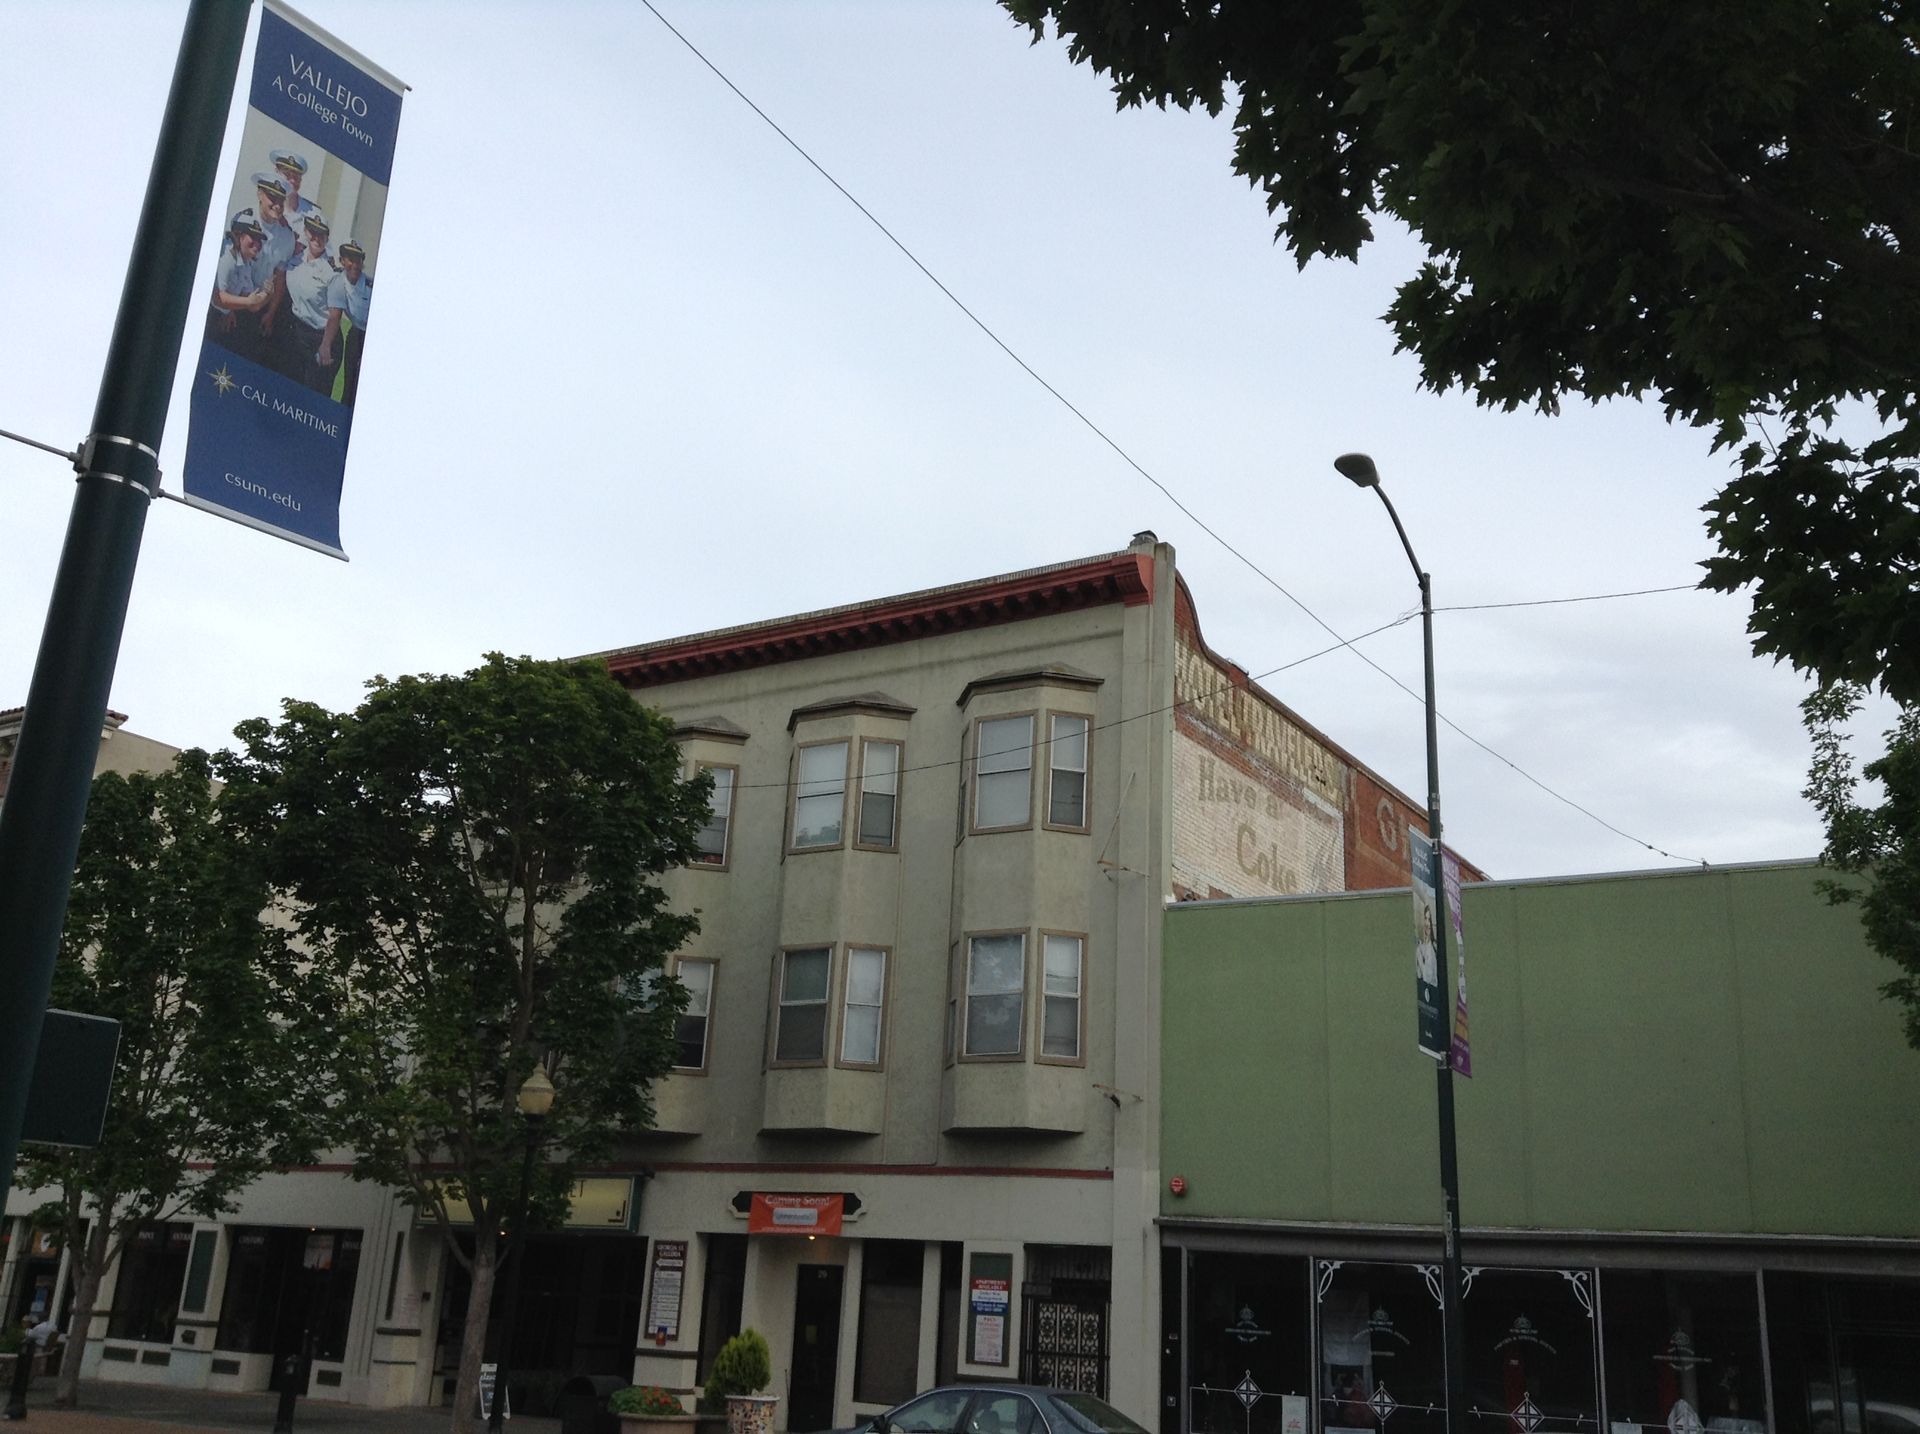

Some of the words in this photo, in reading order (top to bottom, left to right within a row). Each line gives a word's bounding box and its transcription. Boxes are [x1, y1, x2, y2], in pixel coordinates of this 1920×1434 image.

[272, 75, 283, 91] A
[287, 83, 337, 124] College
[341, 114, 373, 147] Town
[290, 54, 368, 118] VALLEJO
[241, 385, 268, 406] CAL
[272, 399, 338, 438] MARITIME
[225, 472, 301, 512] csum.edu
[1199, 754, 1257, 810] Have
[1265, 794, 1279, 821] a
[1237, 822, 1297, 894] Coke
[765, 1194, 801, 1207] Coming
